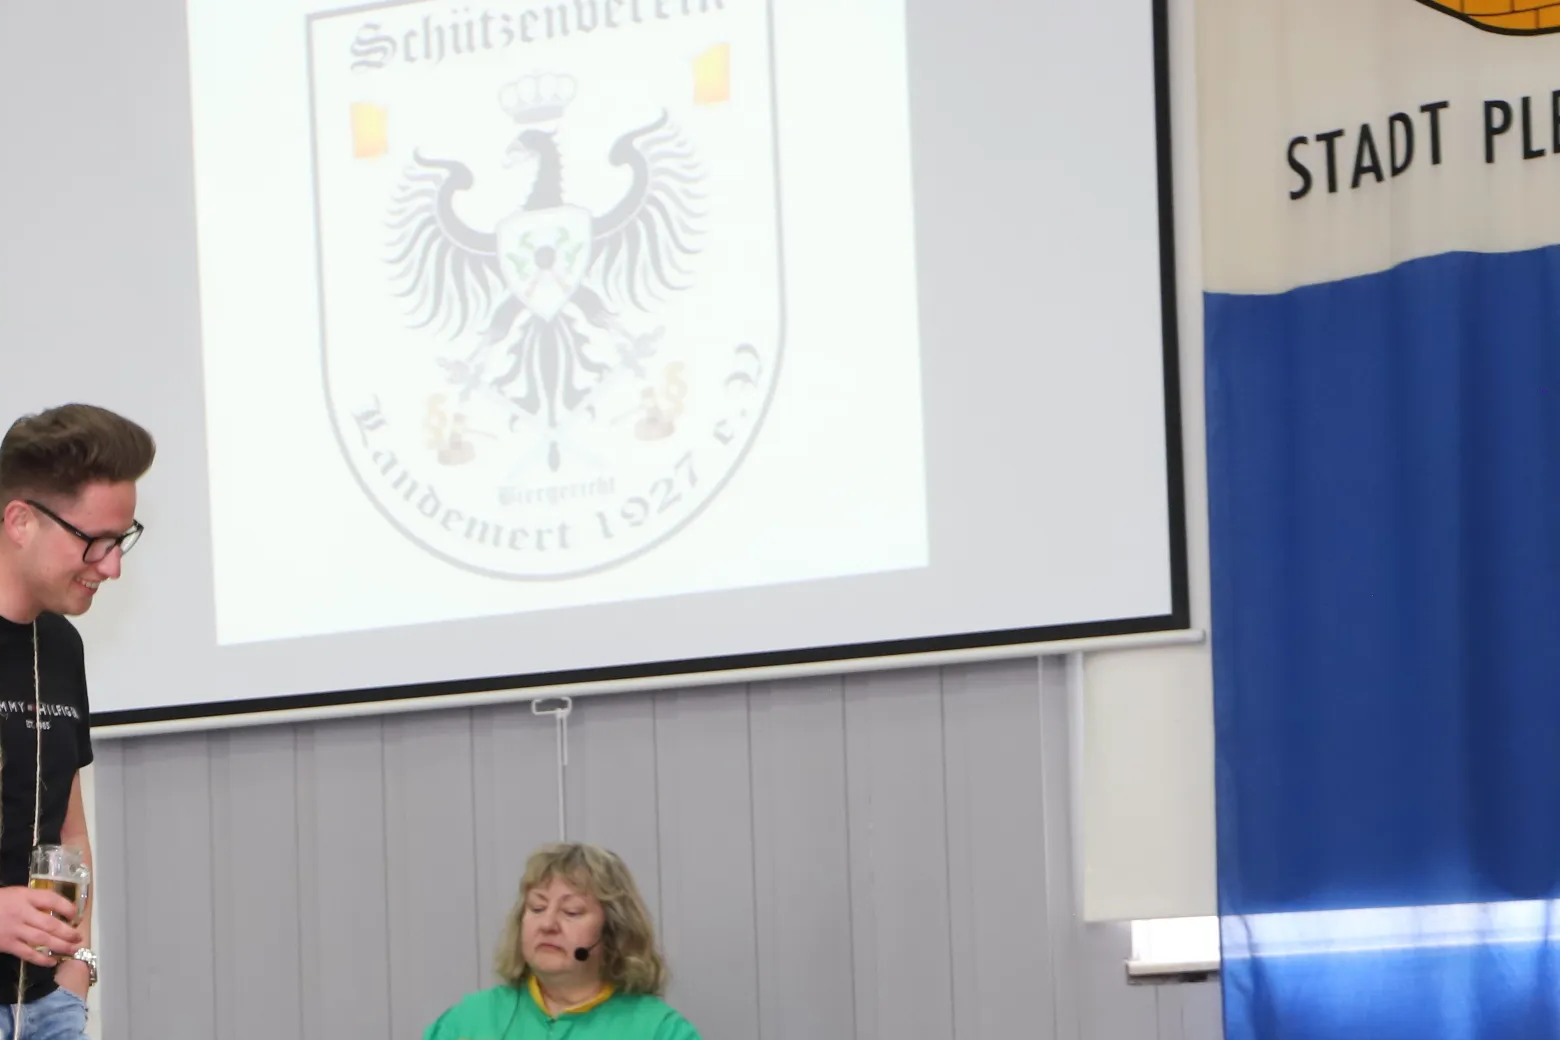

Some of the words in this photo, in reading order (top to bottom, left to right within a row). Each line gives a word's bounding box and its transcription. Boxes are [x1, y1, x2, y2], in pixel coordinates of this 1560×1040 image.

[1286, 100, 1450, 200] STADT
[351, 393, 572, 551] Landemert
[595, 448, 701, 540] 1927
